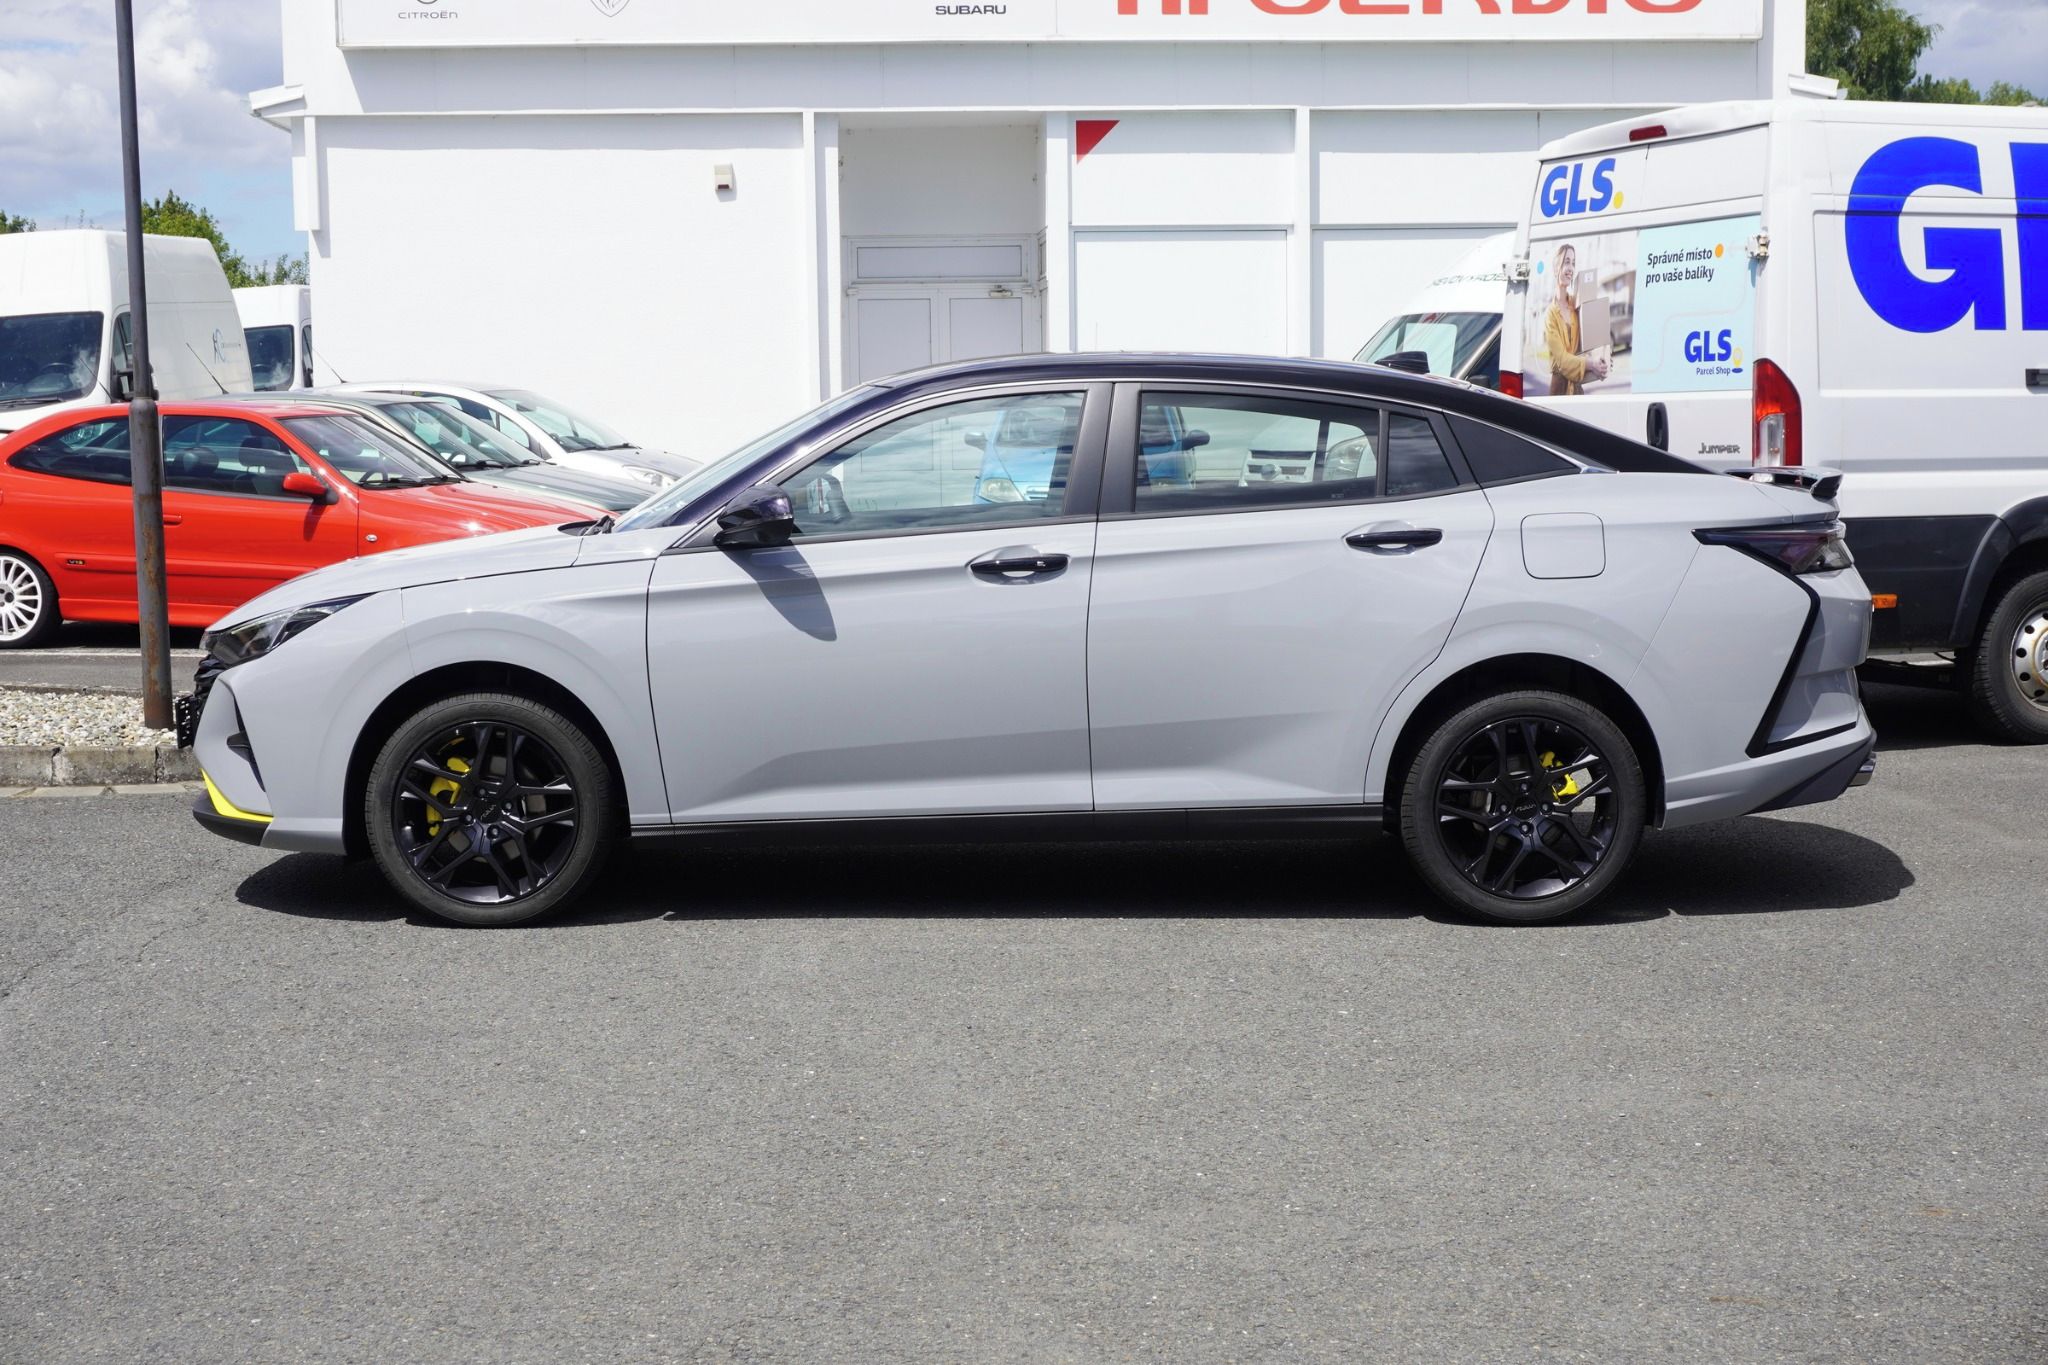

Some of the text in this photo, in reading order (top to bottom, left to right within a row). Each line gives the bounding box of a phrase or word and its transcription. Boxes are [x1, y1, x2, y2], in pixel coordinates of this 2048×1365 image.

[935, 5, 1007, 15] SUBARU
[1647, 247, 1713, 269] Správné místo
[1645, 265, 1715, 288] pro vaše balíky
[1684, 328, 1732, 363] GLS
[1696, 366, 1731, 376] Parcel Shop
